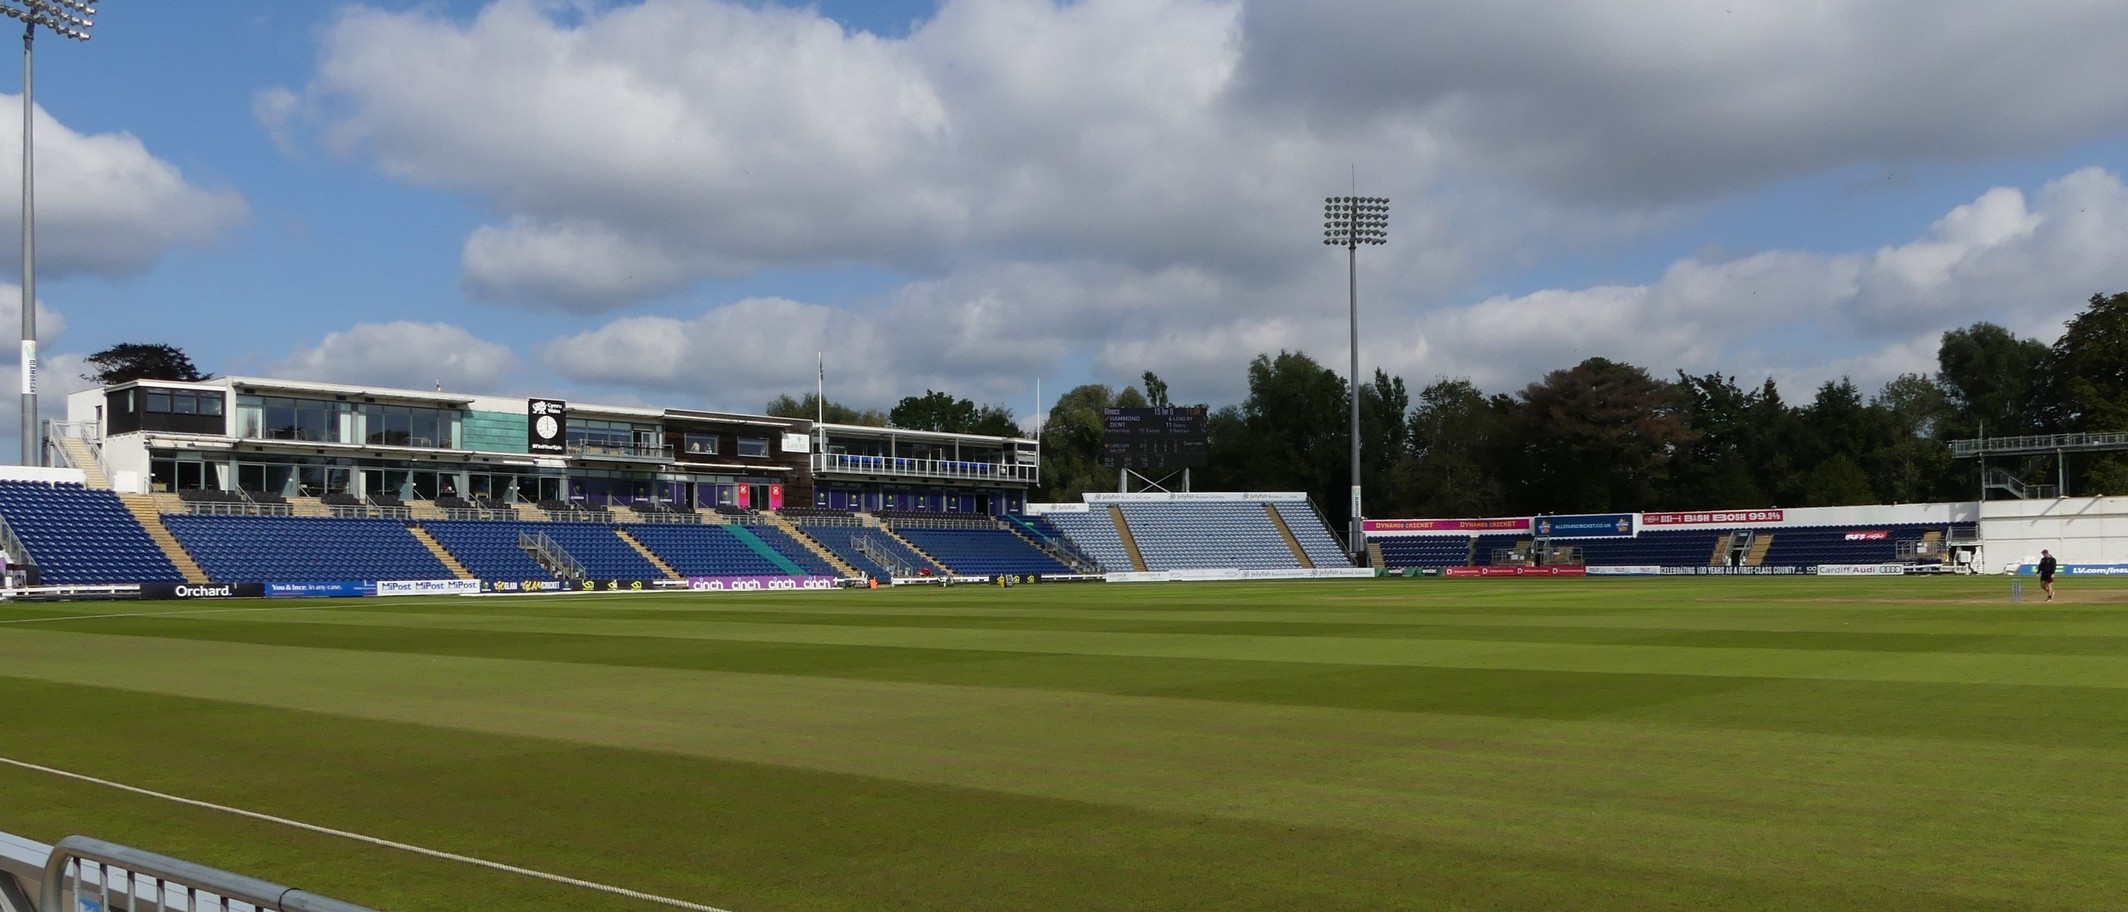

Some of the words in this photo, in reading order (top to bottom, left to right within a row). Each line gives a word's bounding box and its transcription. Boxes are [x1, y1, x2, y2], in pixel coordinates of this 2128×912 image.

[1712, 513, 1746, 521] BOSH
[1748, 512, 1780, 520] 99.9%
[1251, 570, 1270, 578] Jellyfish
[693, 578, 723, 589] cinch
[732, 577, 760, 589] cinch
[768, 576, 796, 589] cinch
[803, 576, 830, 588] cinch
[175, 585, 232, 596] Orchard.
